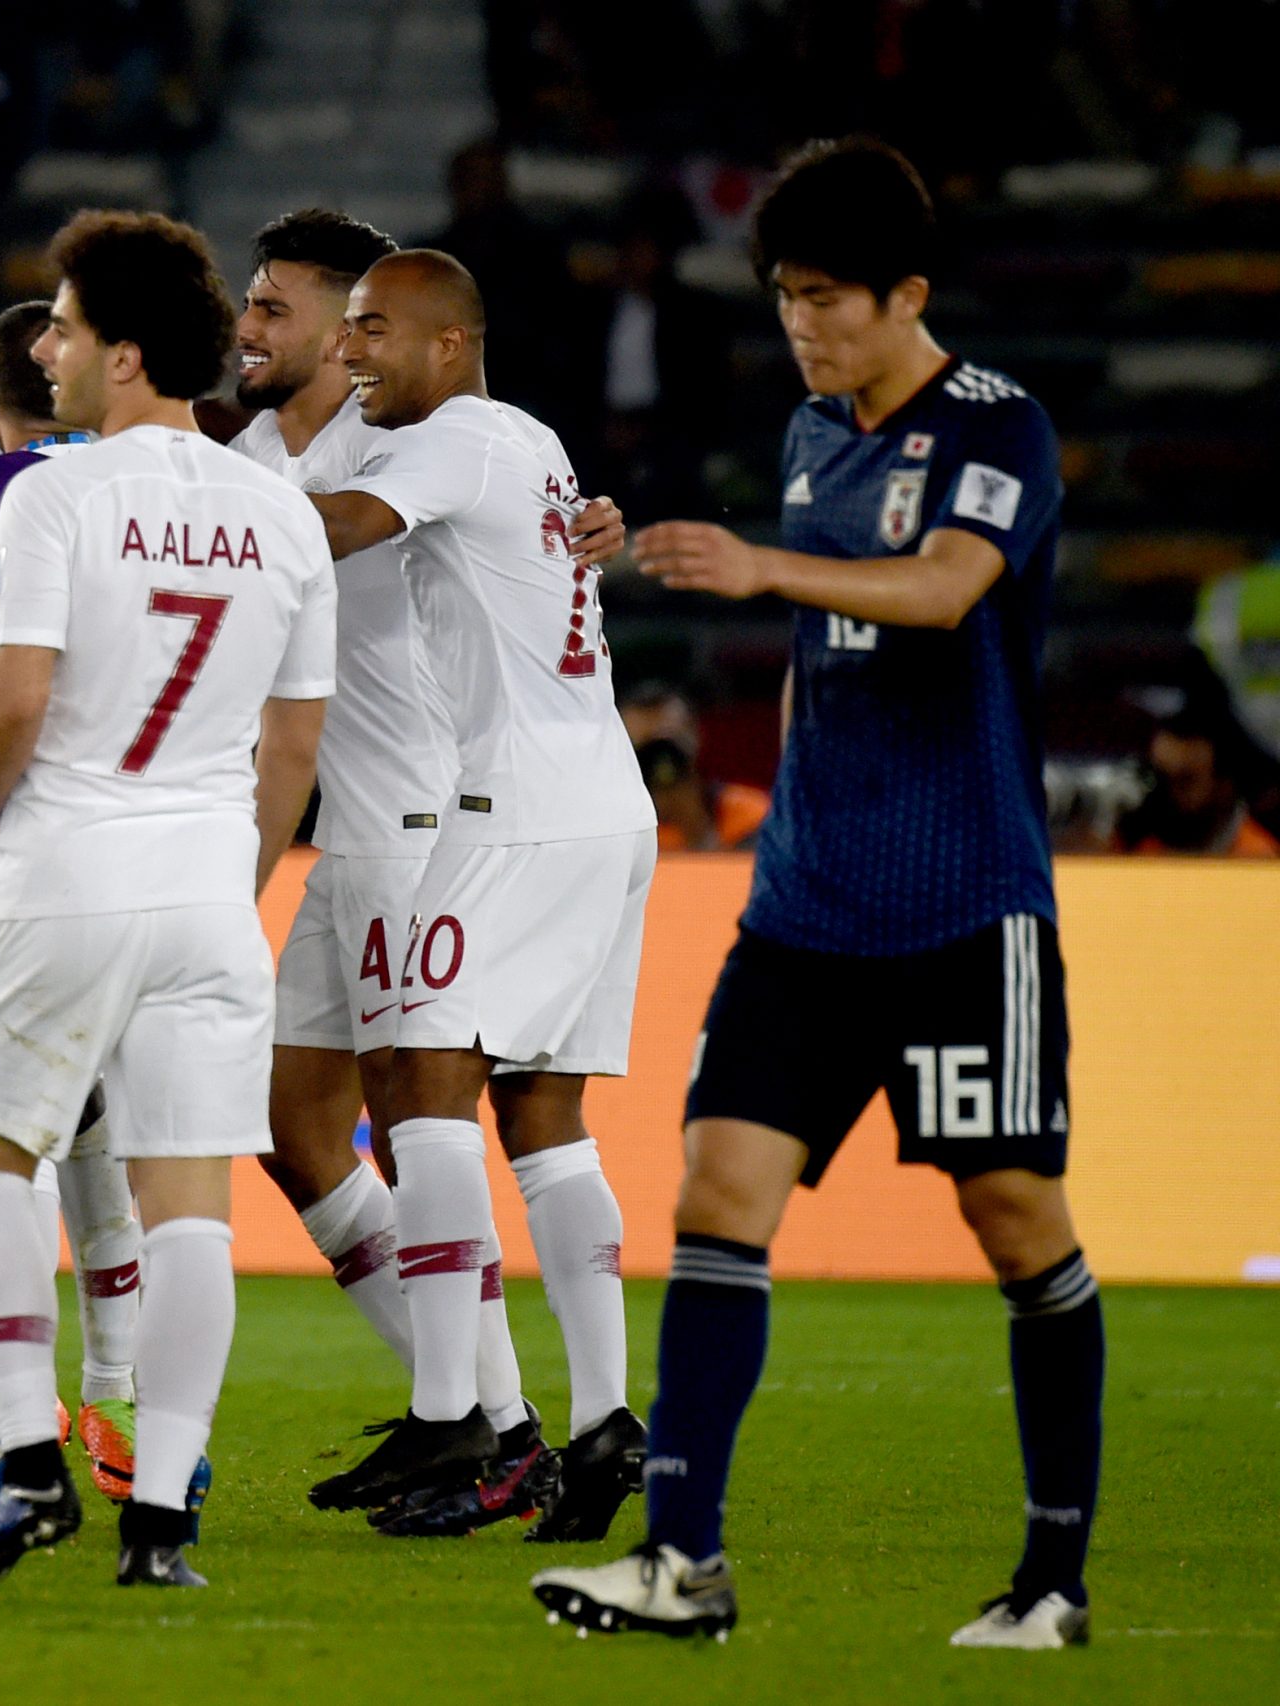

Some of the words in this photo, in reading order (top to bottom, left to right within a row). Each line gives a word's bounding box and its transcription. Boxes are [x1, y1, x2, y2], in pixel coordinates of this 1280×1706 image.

[121, 518, 264, 570] A.ALAA
[115, 587, 234, 777] 7
[359, 916, 392, 991] 4
[400, 912, 465, 991] 20
[903, 1045, 994, 1138] 16
